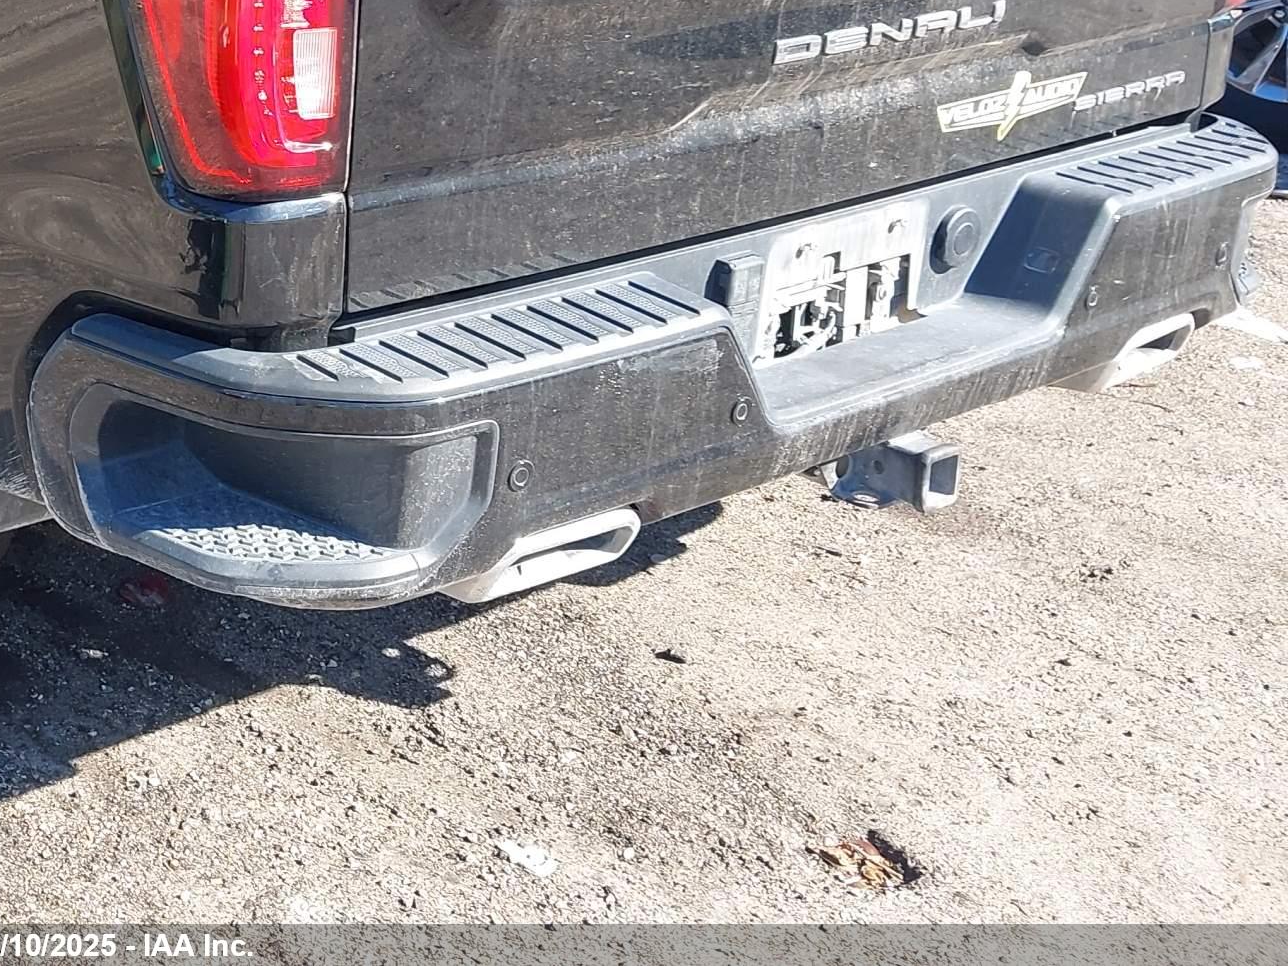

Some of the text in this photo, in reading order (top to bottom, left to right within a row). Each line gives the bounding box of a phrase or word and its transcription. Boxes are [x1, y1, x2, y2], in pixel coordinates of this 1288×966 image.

[772, 0, 1007, 65] DENALI
[945, 77, 1081, 126] VELOZ AUDIO
[1073, 70, 1186, 111] SIERRA
